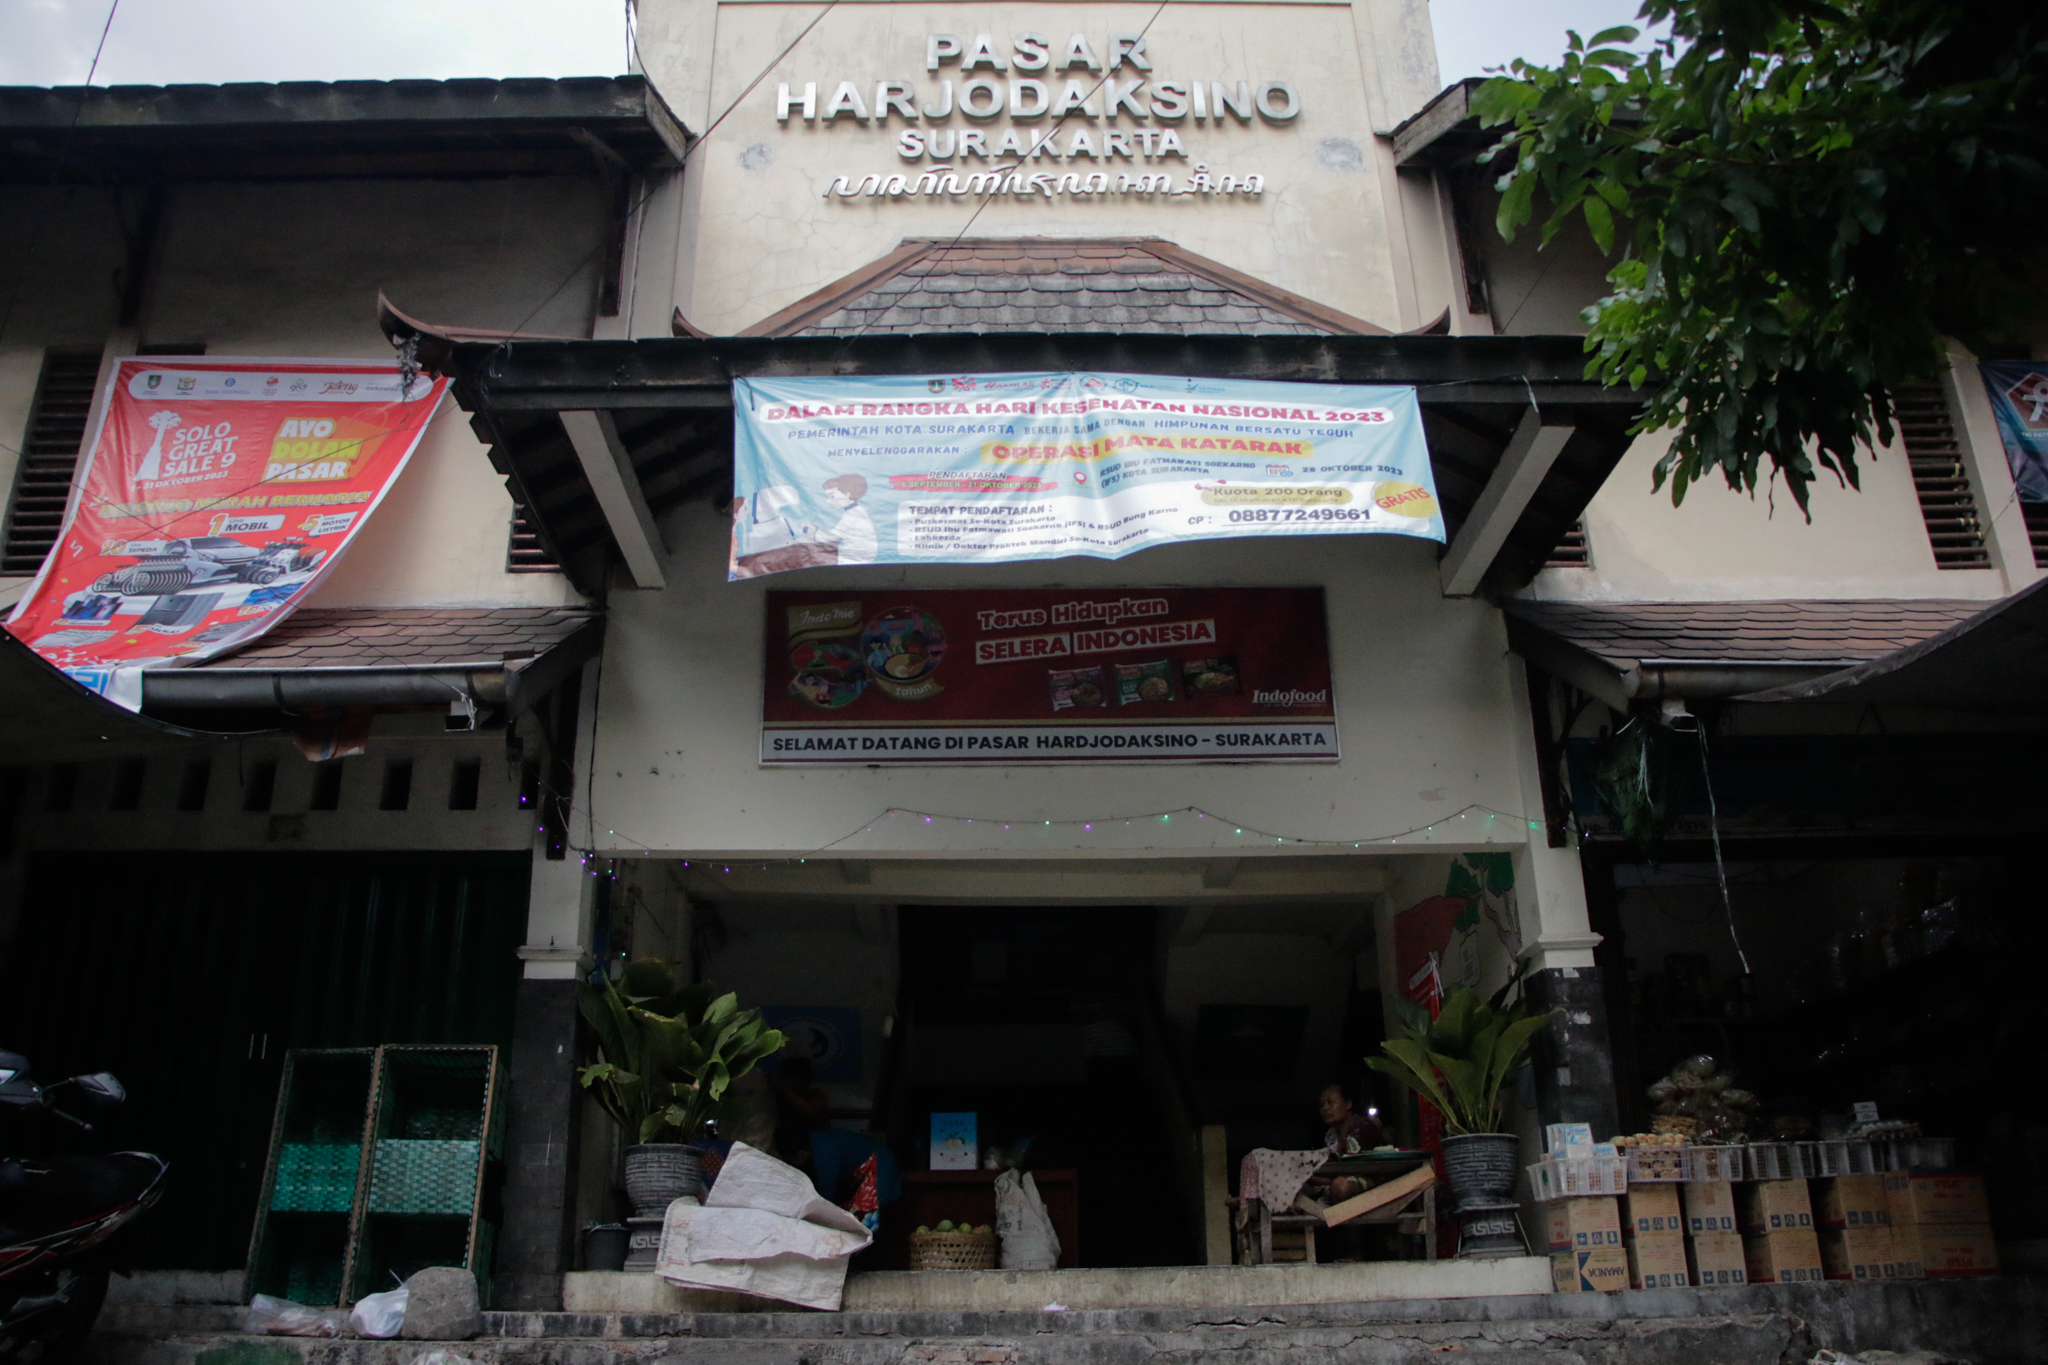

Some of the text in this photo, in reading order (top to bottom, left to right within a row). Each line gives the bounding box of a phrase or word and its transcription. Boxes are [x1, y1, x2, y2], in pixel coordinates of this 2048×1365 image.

[927, 32, 1152, 72] PASAR
[777, 79, 1300, 122] HARJODAKSINO
[897, 128, 1188, 158] SURAKARTA
[768, 398, 1385, 422] DALAM RANGKA HARI KESEHATAN NASIONAL 2023
[173, 422, 232, 445] SOLO
[279, 420, 333, 438] AYO
[788, 418, 1353, 440] PEMERINTAH KOTA SURAKARTA BEKERJA SAMA DENGAN HIMPUNAN BERSATU TEGUH
[169, 436, 239, 460] GREAT
[274, 439, 363, 459] DOLAN
[828, 446, 960, 457] MENYELENGGARAKAN
[992, 435, 1302, 459] OPERASI MATA KATARAK
[162, 452, 237, 478] SALE 9
[265, 461, 348, 480] PASAR
[1100, 462, 1121, 478] RSUD
[1143, 458, 1201, 467] FATMAWATI
[1205, 461, 1256, 469] SOEKARNO
[1122, 469, 1147, 479] KOTA
[1151, 466, 1210, 475] SURAKARTA
[1378, 465, 1403, 476] 2023
[155, 475, 204, 487] OKTOBER
[204, 470, 229, 480] 2023
[928, 471, 1007, 480] PENDAFTARAN
[979, 481, 1020, 489] OKTOBER
[1213, 487, 1342, 497] Kuota 200 Orang
[1376, 487, 1430, 509] GRATIS
[97, 499, 194, 518] BELONJO
[194, 496, 267, 511] MURAH
[909, 506, 956, 515] TEMPAT
[960, 505, 1045, 515] PENDAFTARAN
[1228, 509, 1371, 522] 08877249661
[208, 513, 229, 537] 1
[225, 522, 269, 532] MOBIL
[302, 514, 323, 530] 5
[318, 525, 347, 533] LISTRIK
[321, 518, 351, 526] MOTOR
[1009, 515, 1056, 525] Surakarta
[1017, 523, 1061, 532] Soekarno
[1097, 520, 1121, 530] RSUD
[1123, 512, 1146, 524] Bung
[1148, 507, 1178, 516] Karno
[1188, 516, 1204, 525] CP
[990, 541, 1027, 550] Praktek
[1030, 537, 1066, 546] Mandiri
[1108, 528, 1148, 546] Surakarta
[979, 599, 1168, 630] Terus Hidupkan
[980, 622, 1212, 660] SELERA INDONESIA
[895, 683, 932, 697] tahun
[1252, 689, 1327, 708] Indofood
[772, 737, 858, 752] SELAMAT
[861, 736, 941, 751] DATANG
[945, 736, 964, 750] DI
[967, 736, 1030, 750] PASAR
[1037, 734, 1198, 750] HARDJODAKSINO
[1215, 732, 1326, 747] SURAKARTA
[1588, 1266, 1625, 1278] AMANDA
